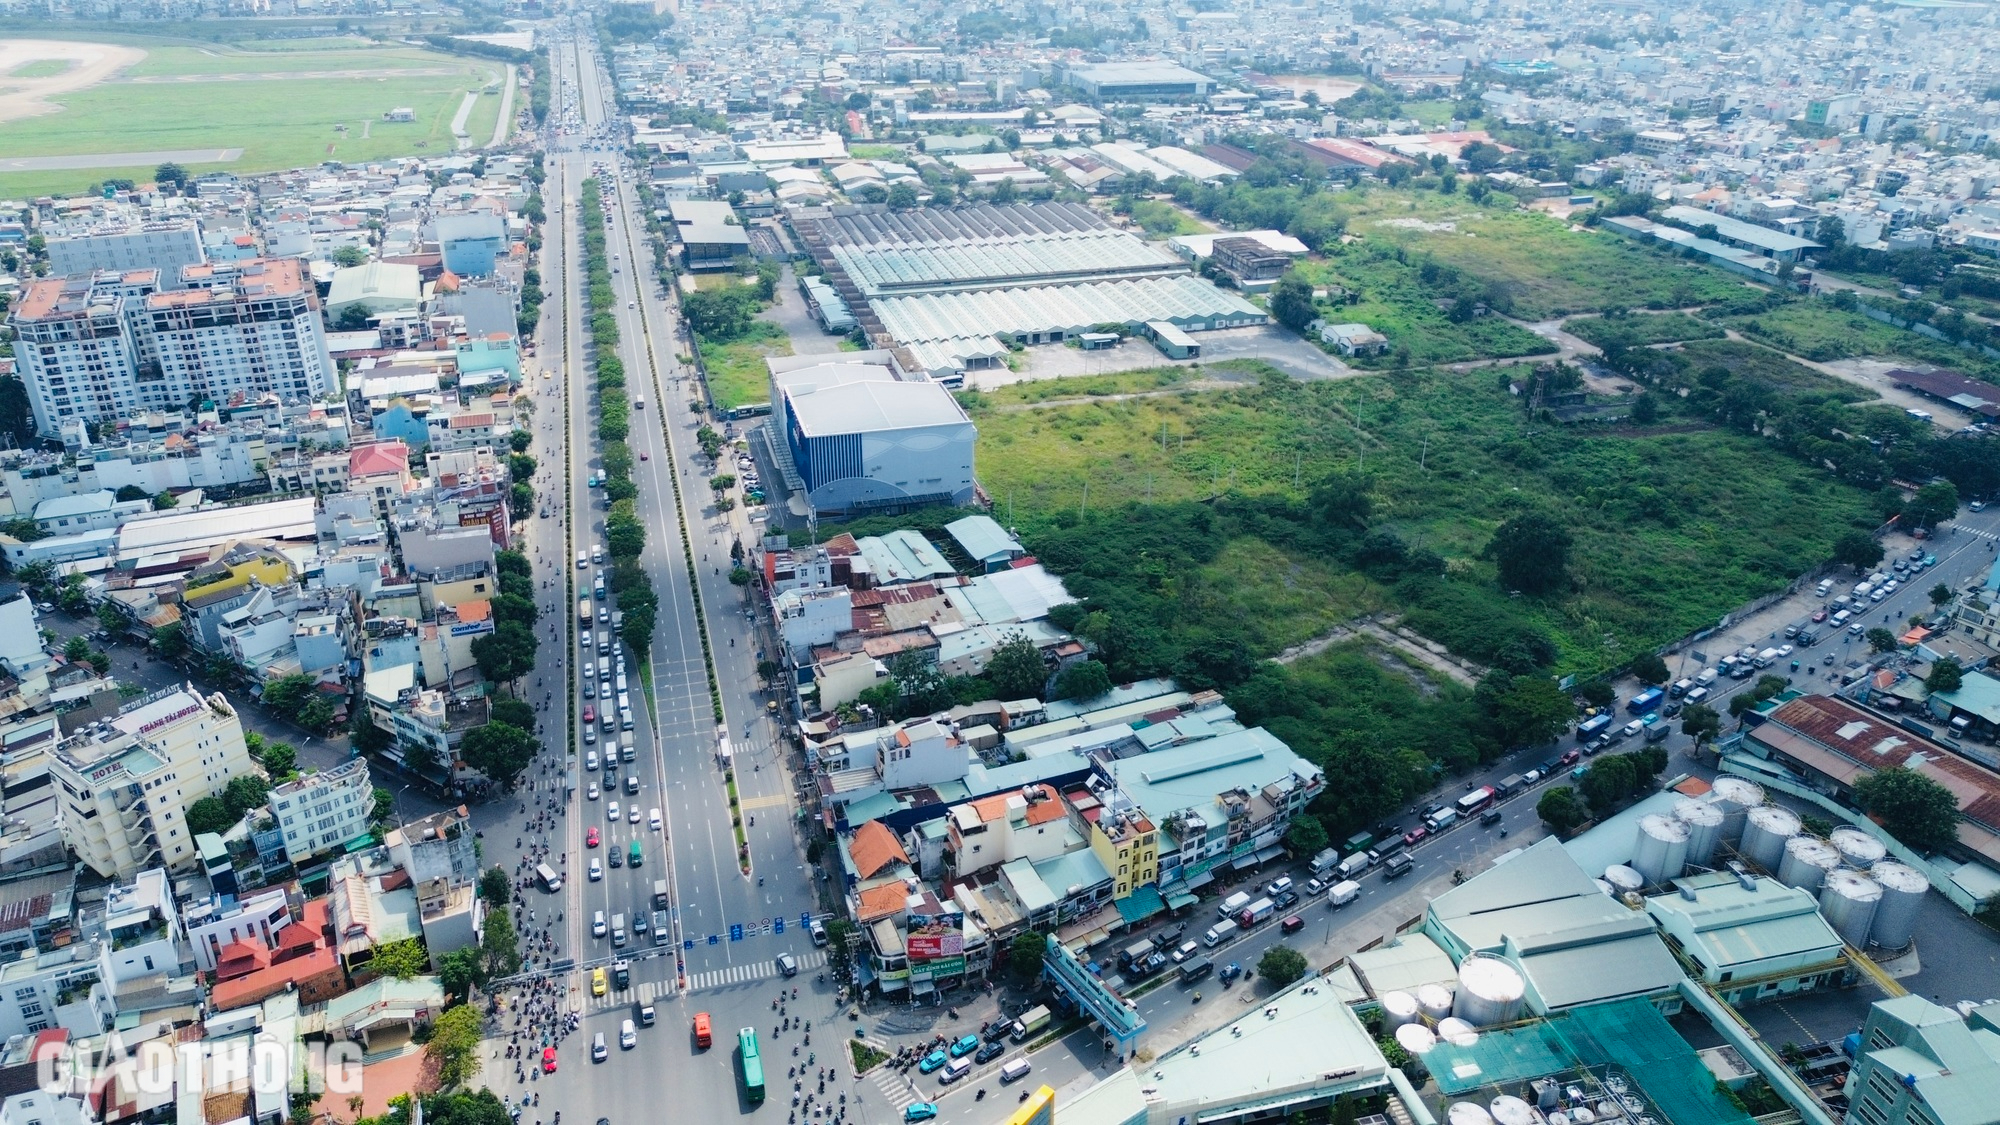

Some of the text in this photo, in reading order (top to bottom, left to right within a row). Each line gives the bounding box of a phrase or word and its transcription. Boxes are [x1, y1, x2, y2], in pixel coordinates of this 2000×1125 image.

[138, 703, 200, 734] THÀNH TÀI HOTEL
[91, 761, 124, 781] HOTEL
